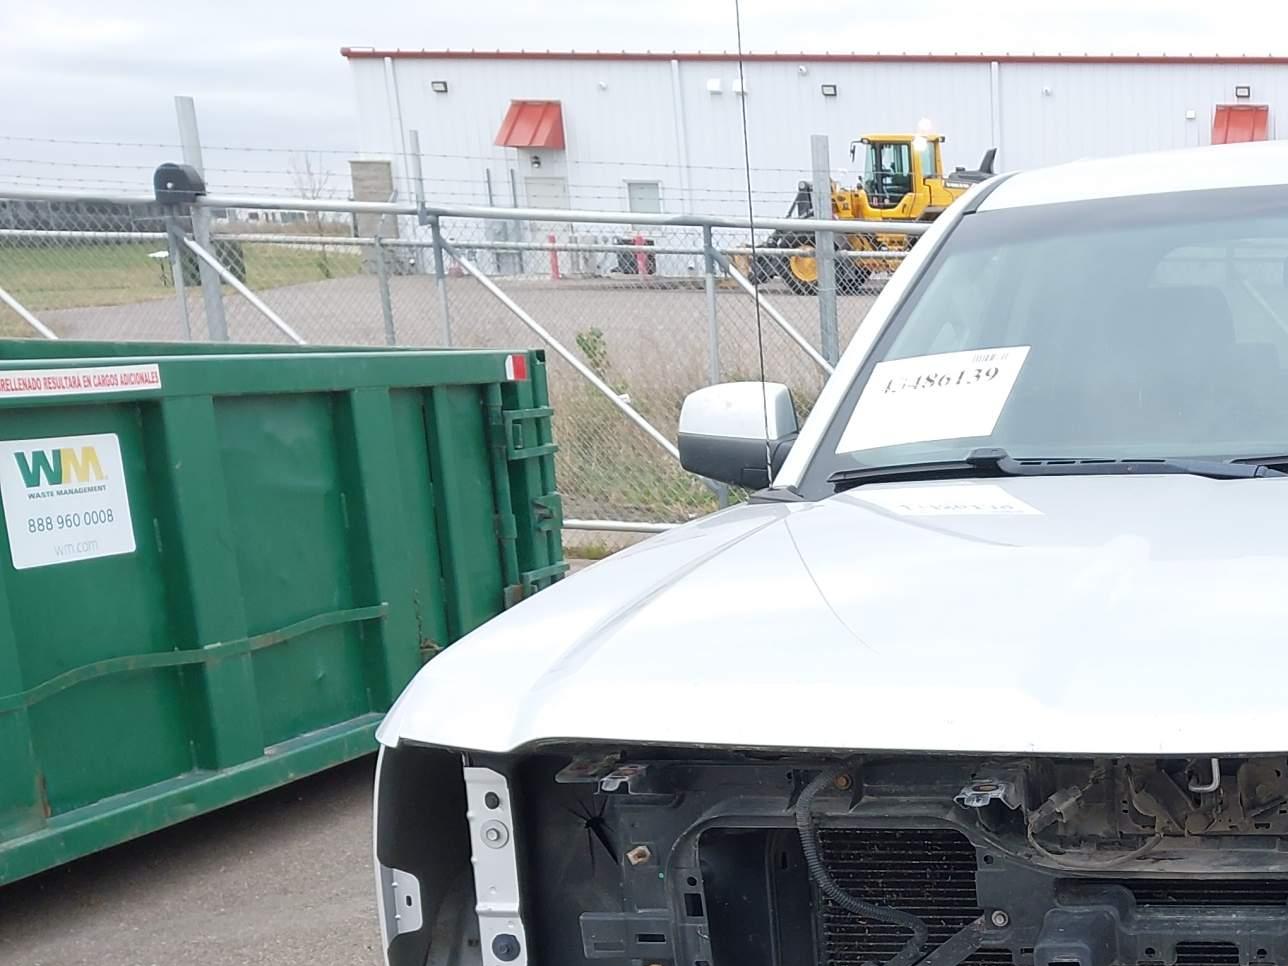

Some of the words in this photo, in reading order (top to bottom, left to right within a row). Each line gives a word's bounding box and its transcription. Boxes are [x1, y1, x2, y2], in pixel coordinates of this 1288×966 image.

[83, 375, 92, 388] EN
[92, 373, 119, 387] CARGOS
[120, 371, 159, 385] ADICIONALES
[883, 367, 999, 394] 4486139
[14, 446, 105, 488] WM
[28, 490, 54, 500] WASTE
[56, 484, 107, 496] MANAGEMENT
[28, 516, 54, 534] 888
[56, 512, 81, 530] 960
[83, 508, 114, 526] 0008
[54, 540, 98, 557] wm.com
